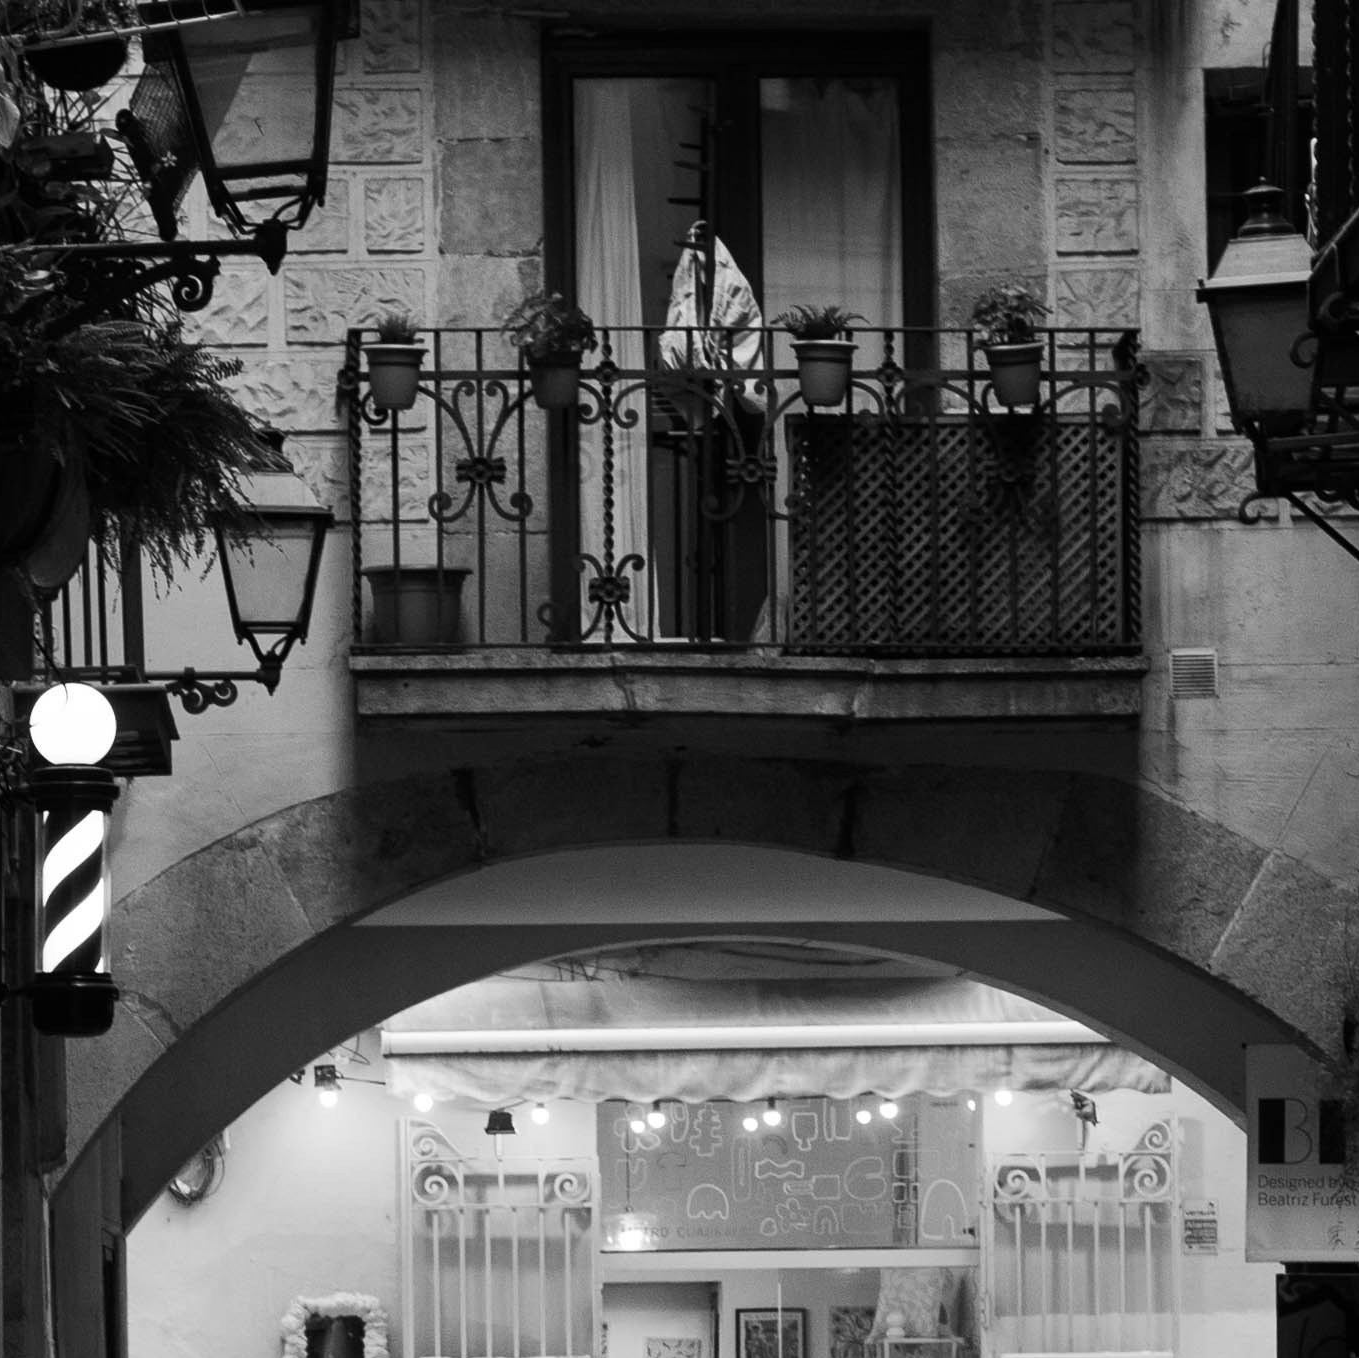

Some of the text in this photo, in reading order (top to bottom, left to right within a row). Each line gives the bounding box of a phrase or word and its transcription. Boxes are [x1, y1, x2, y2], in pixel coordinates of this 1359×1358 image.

[1257, 1174, 1325, 1192] Designed
[1257, 1191, 1357, 1207] Beatriz Furest
